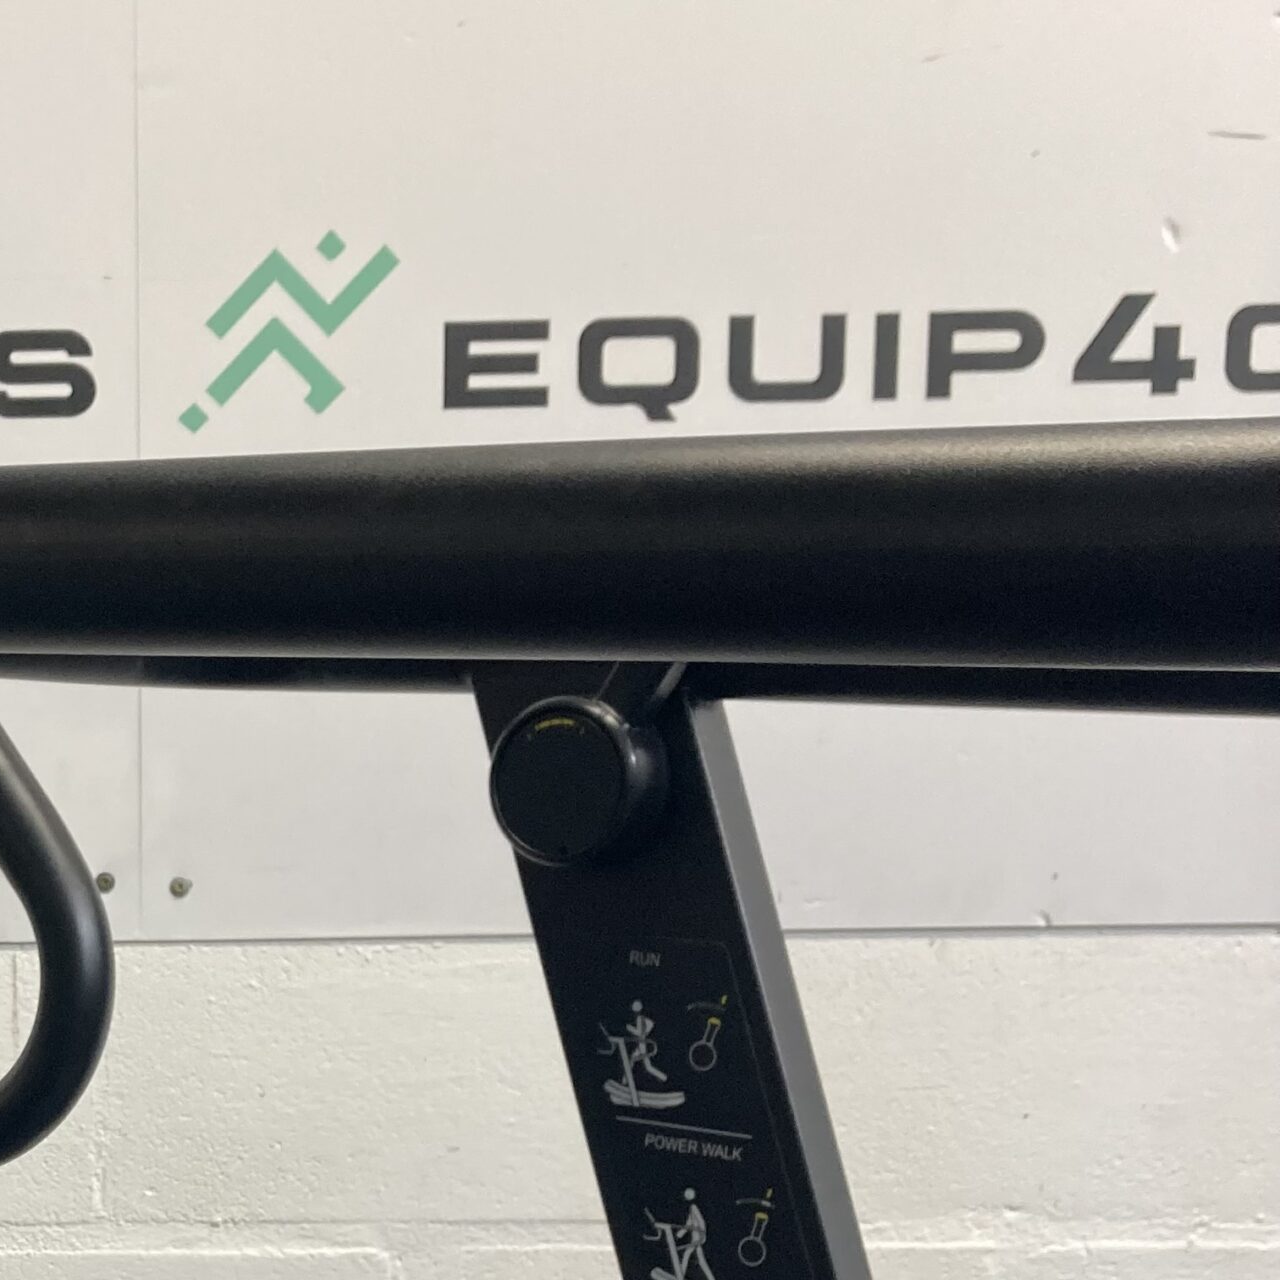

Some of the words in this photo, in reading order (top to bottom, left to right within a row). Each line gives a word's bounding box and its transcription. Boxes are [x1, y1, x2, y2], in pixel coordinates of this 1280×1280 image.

[629, 950, 661, 967] RUN
[644, 1133, 698, 1154] POWER
[701, 1142, 744, 1162] WALK
